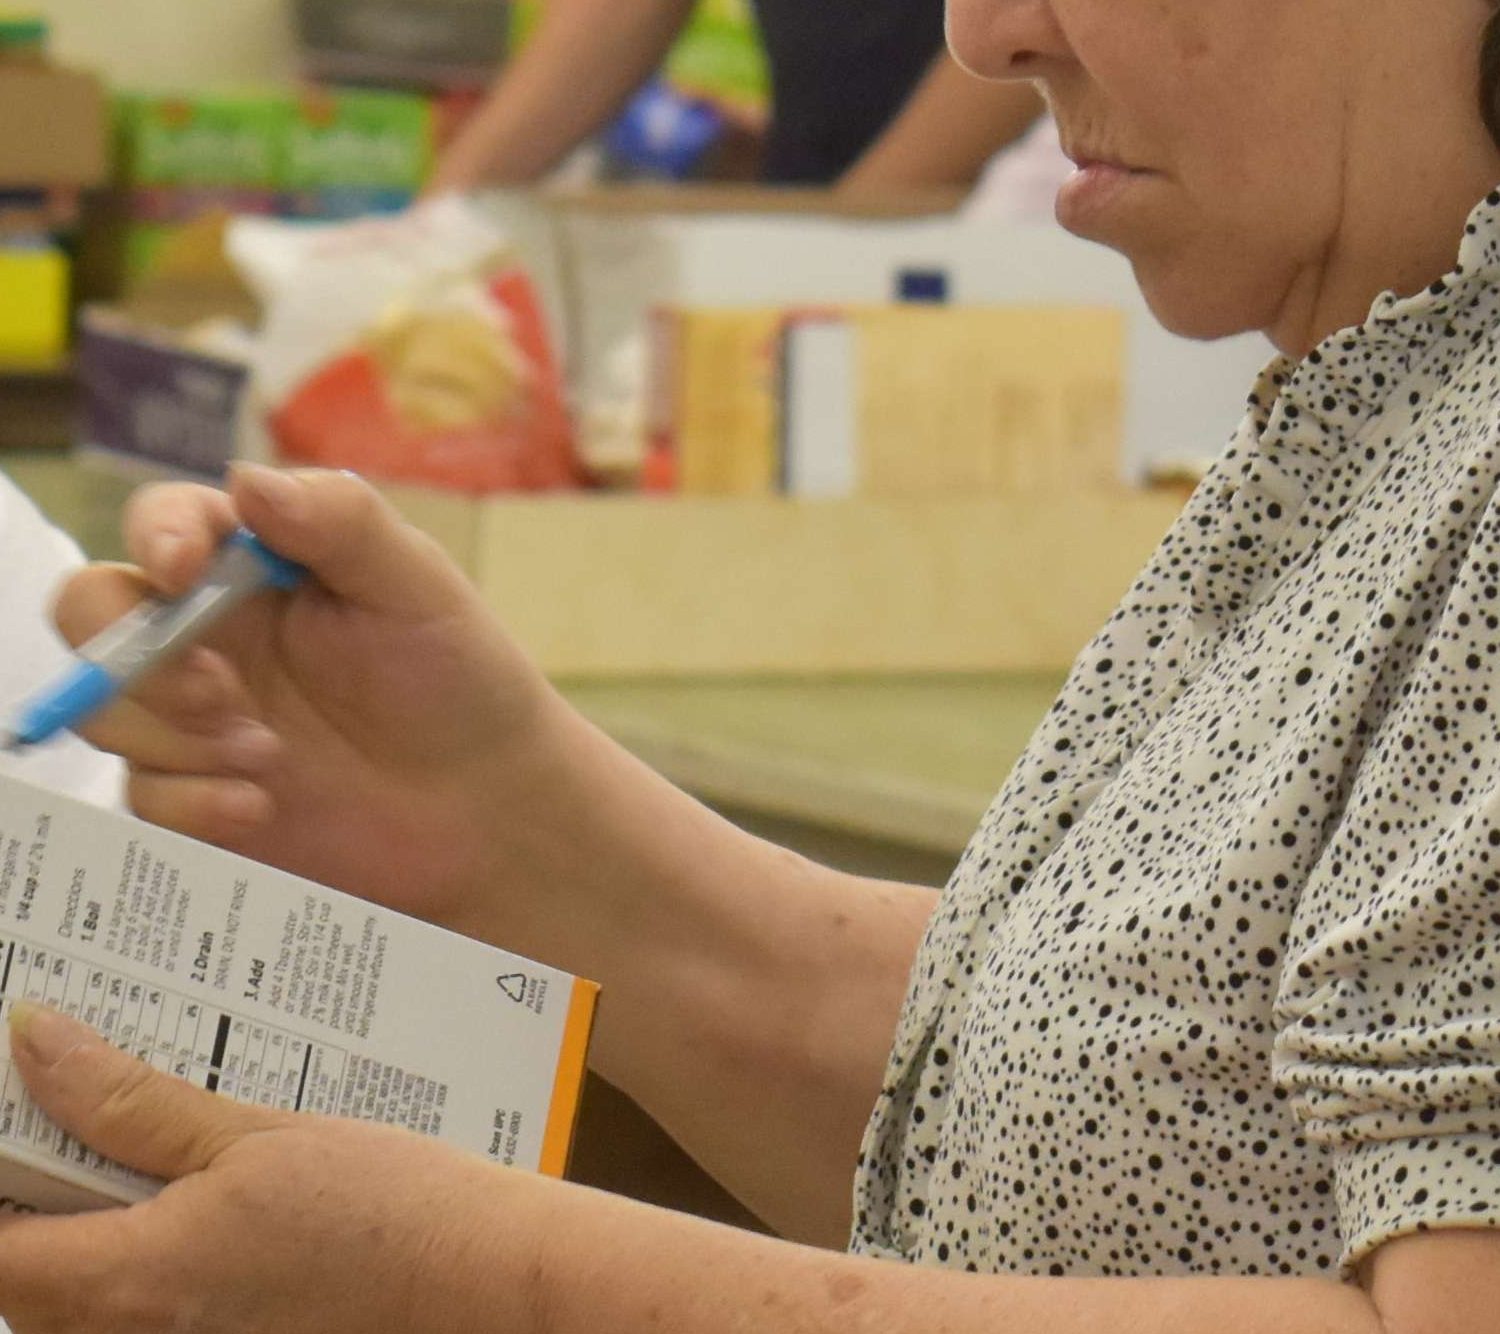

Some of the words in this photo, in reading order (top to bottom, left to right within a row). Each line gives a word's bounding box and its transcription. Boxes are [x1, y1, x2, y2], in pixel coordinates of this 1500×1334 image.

[56, 864, 86, 939] Directions
[82, 899, 102, 931] Boil
[192, 928, 216, 970] Drain
[245, 957, 266, 990] Add
[492, 1106, 508, 1130] UPC
[488, 1130, 504, 1156] Scan
